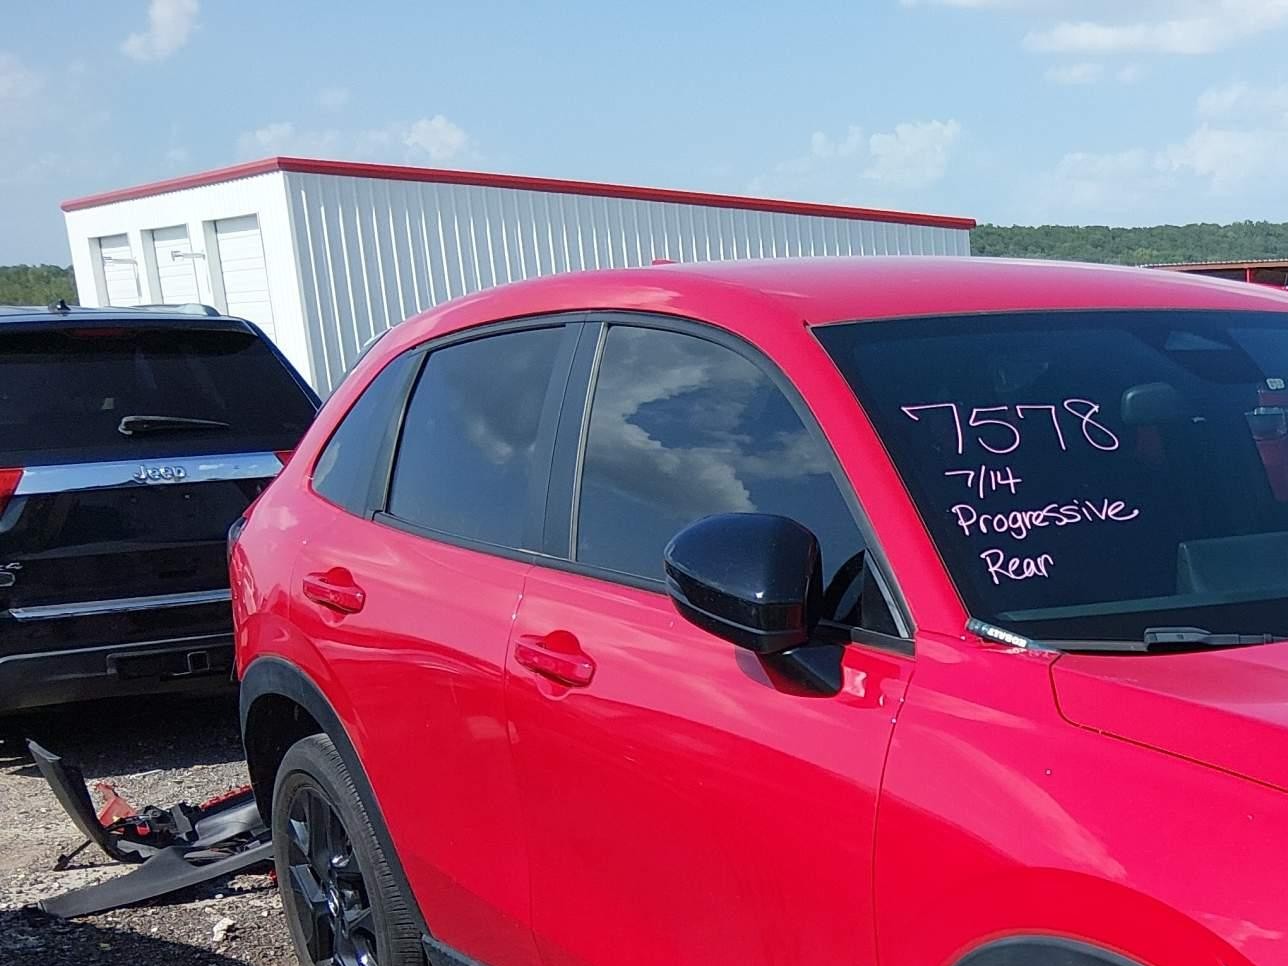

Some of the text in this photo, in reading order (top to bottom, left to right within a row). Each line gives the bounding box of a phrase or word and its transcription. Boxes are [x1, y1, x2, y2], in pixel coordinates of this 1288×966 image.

[900, 398, 1120, 455] 7578
[133, 465, 187, 481] Jeep
[944, 465, 1022, 499] 7/14
[950, 498, 1140, 540] Progressive
[980, 549, 1054, 585] Rear
